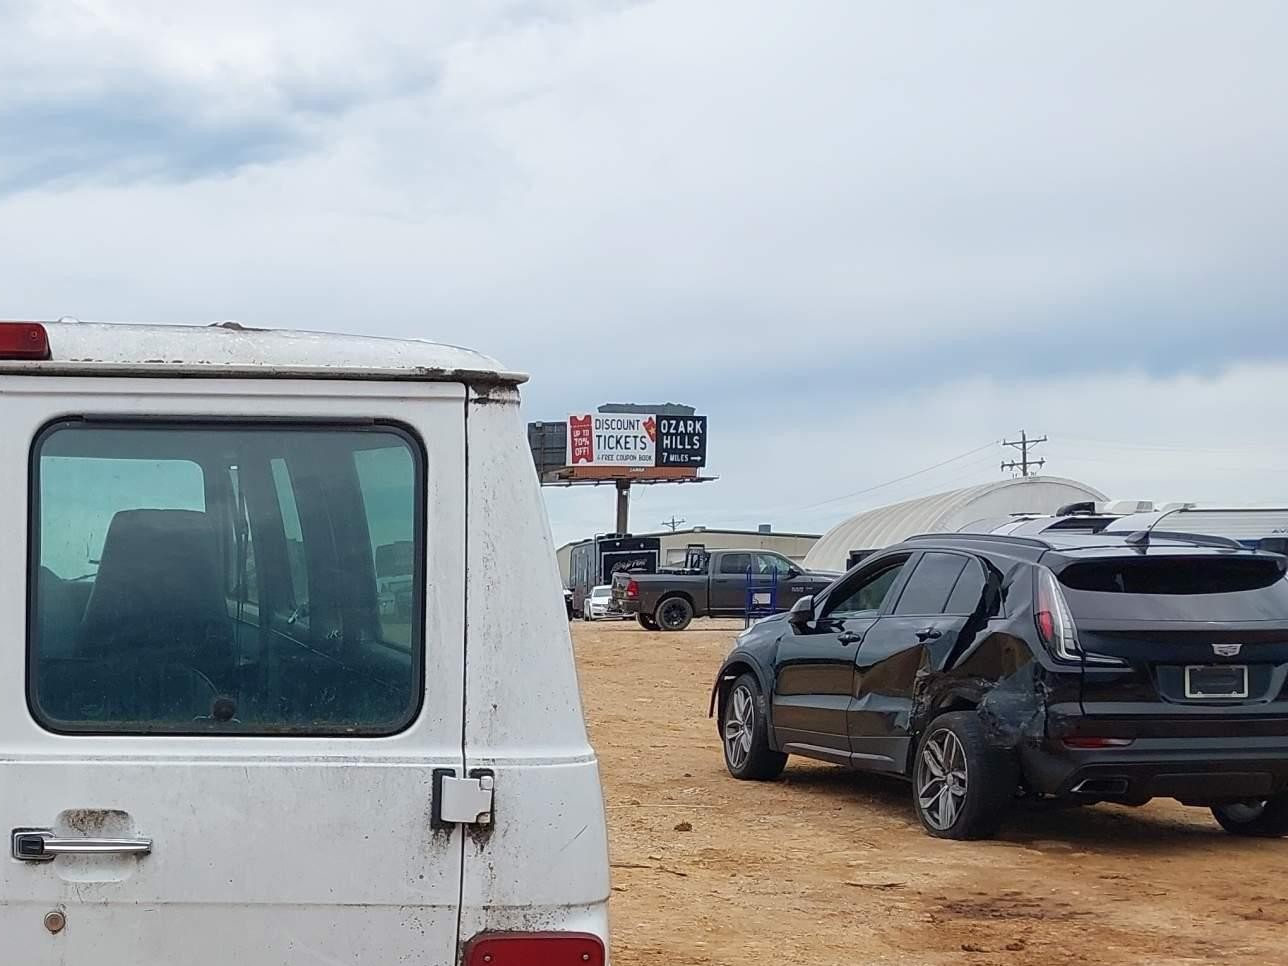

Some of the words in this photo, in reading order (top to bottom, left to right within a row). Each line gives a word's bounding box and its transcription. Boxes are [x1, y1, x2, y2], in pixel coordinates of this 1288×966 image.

[595, 418, 640, 431] DISCOUNT
[660, 420, 703, 434] OZARK
[582, 429, 590, 437] TO
[574, 437, 590, 446] 70%
[596, 435, 647, 451] TICKETS
[663, 436, 700, 449] HILLS
[663, 453, 668, 463] 7
[670, 454, 689, 462] MILES
